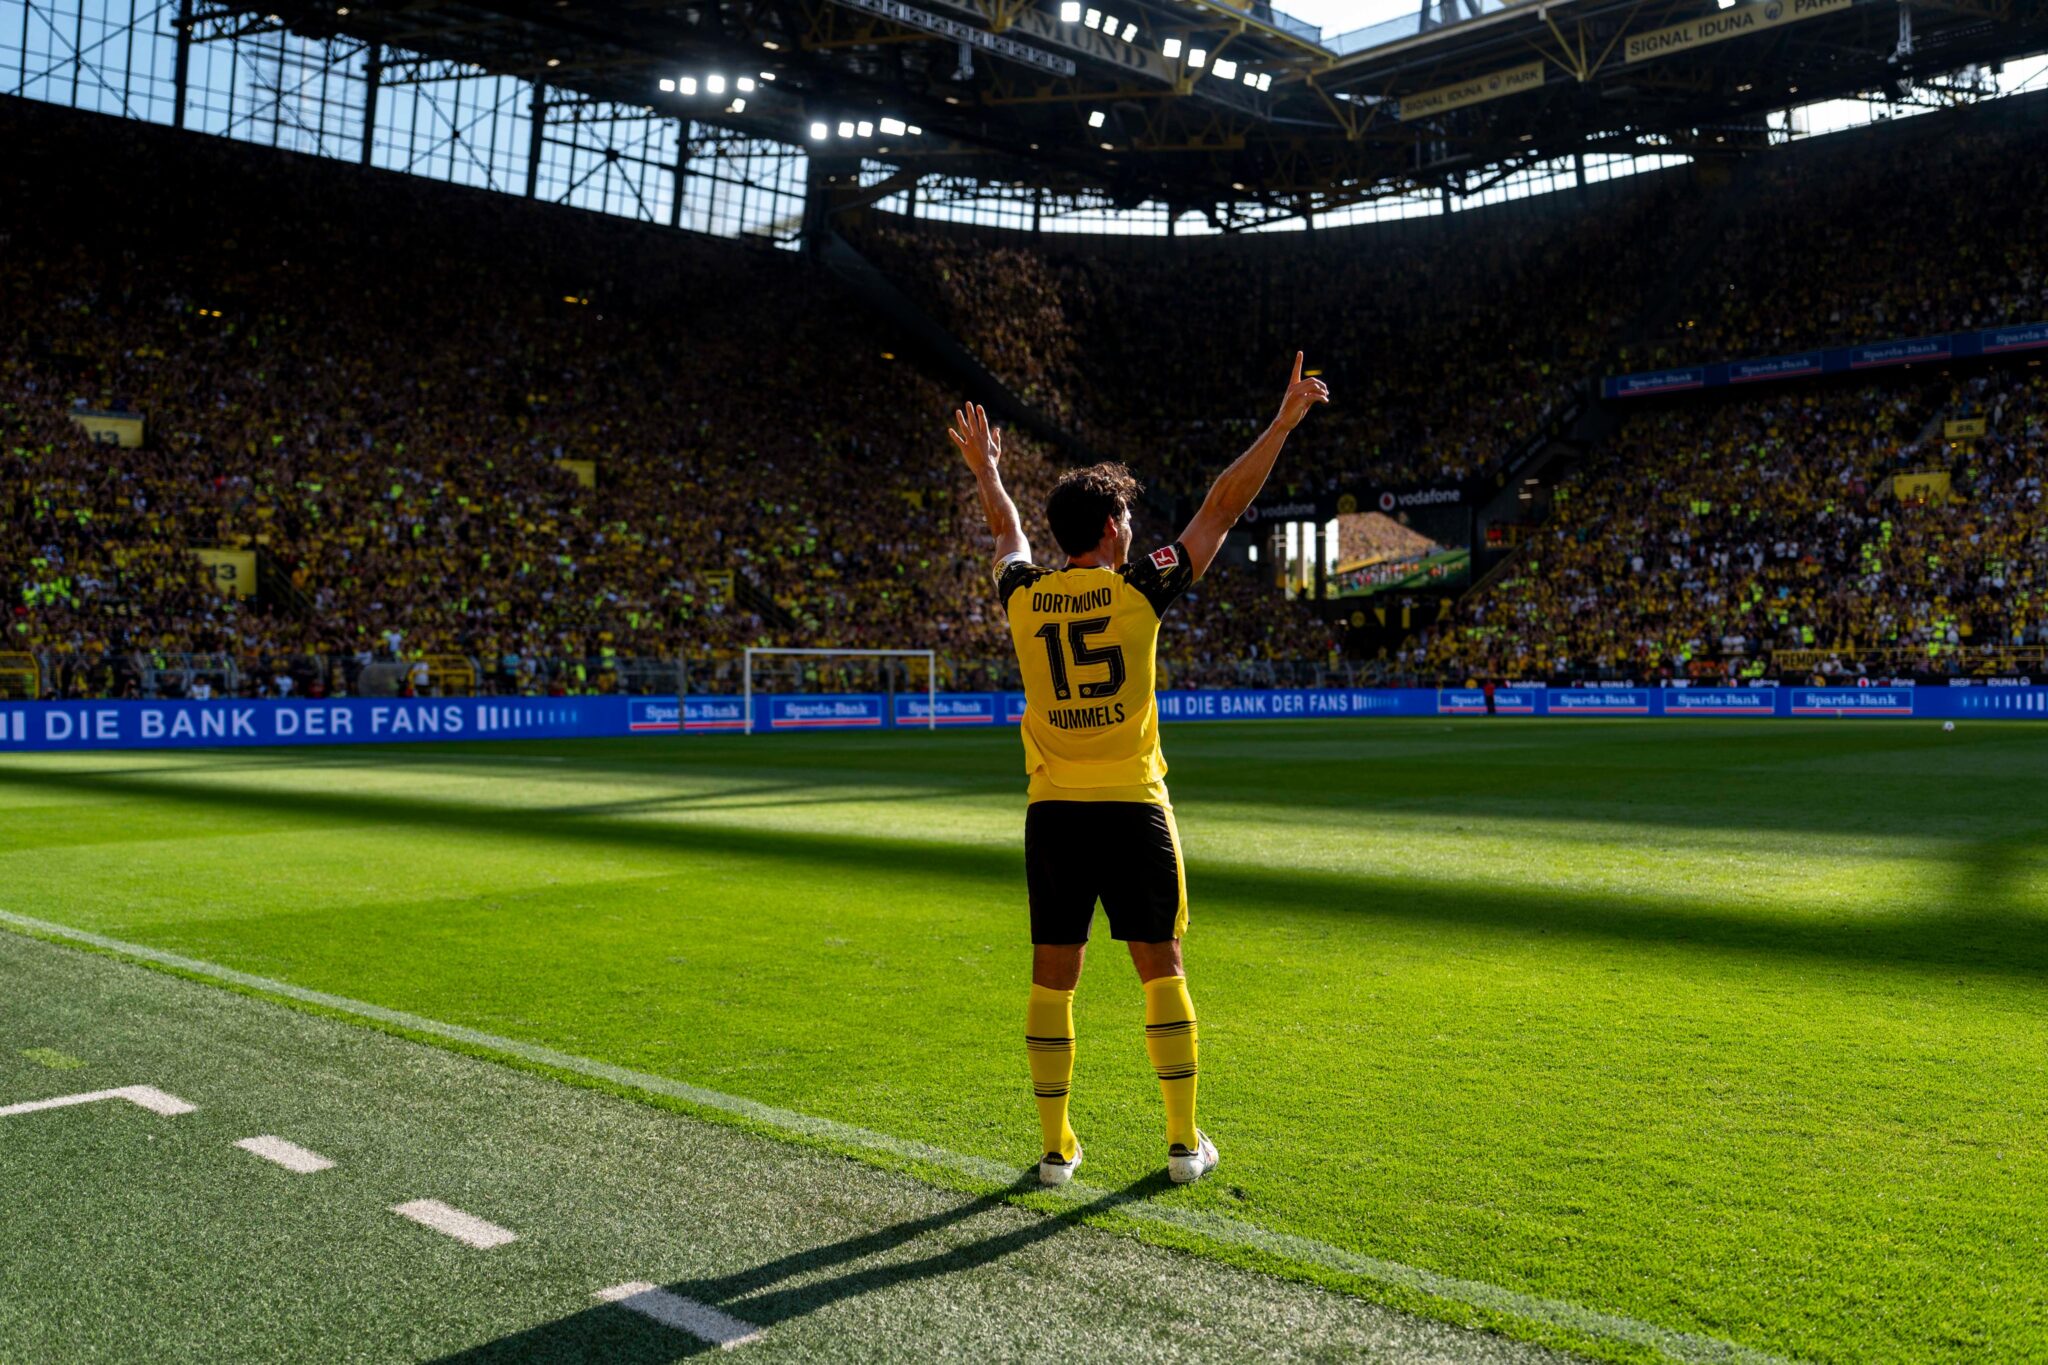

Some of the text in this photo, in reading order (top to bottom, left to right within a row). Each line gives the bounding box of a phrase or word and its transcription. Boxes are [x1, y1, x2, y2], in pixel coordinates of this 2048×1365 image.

[1631, 30, 1699, 60] SIGNAL
[1705, 13, 1765, 42] IDUNA
[1405, 70, 1537, 113] SIGNAL IDUNA PARK
[1863, 342, 1938, 361] Sparda-Bank
[1397, 488, 1461, 506] vodafone
[1261, 501, 1316, 518] vodafone
[1032, 587, 1112, 613] DORTMUND
[1034, 616, 1126, 700] 15
[1185, 694, 1348, 715] DIE BANK DER FANS
[1560, 694, 1636, 707] Sparda-Bank
[1677, 693, 1760, 708] Sparda-Bank
[1806, 692, 1898, 708] Sparda-Bank
[785, 702, 867, 720] Sparda-Bank
[1048, 702, 1126, 730] HUMMELS
[45, 705, 464, 740] DIE BANK DER FANS
